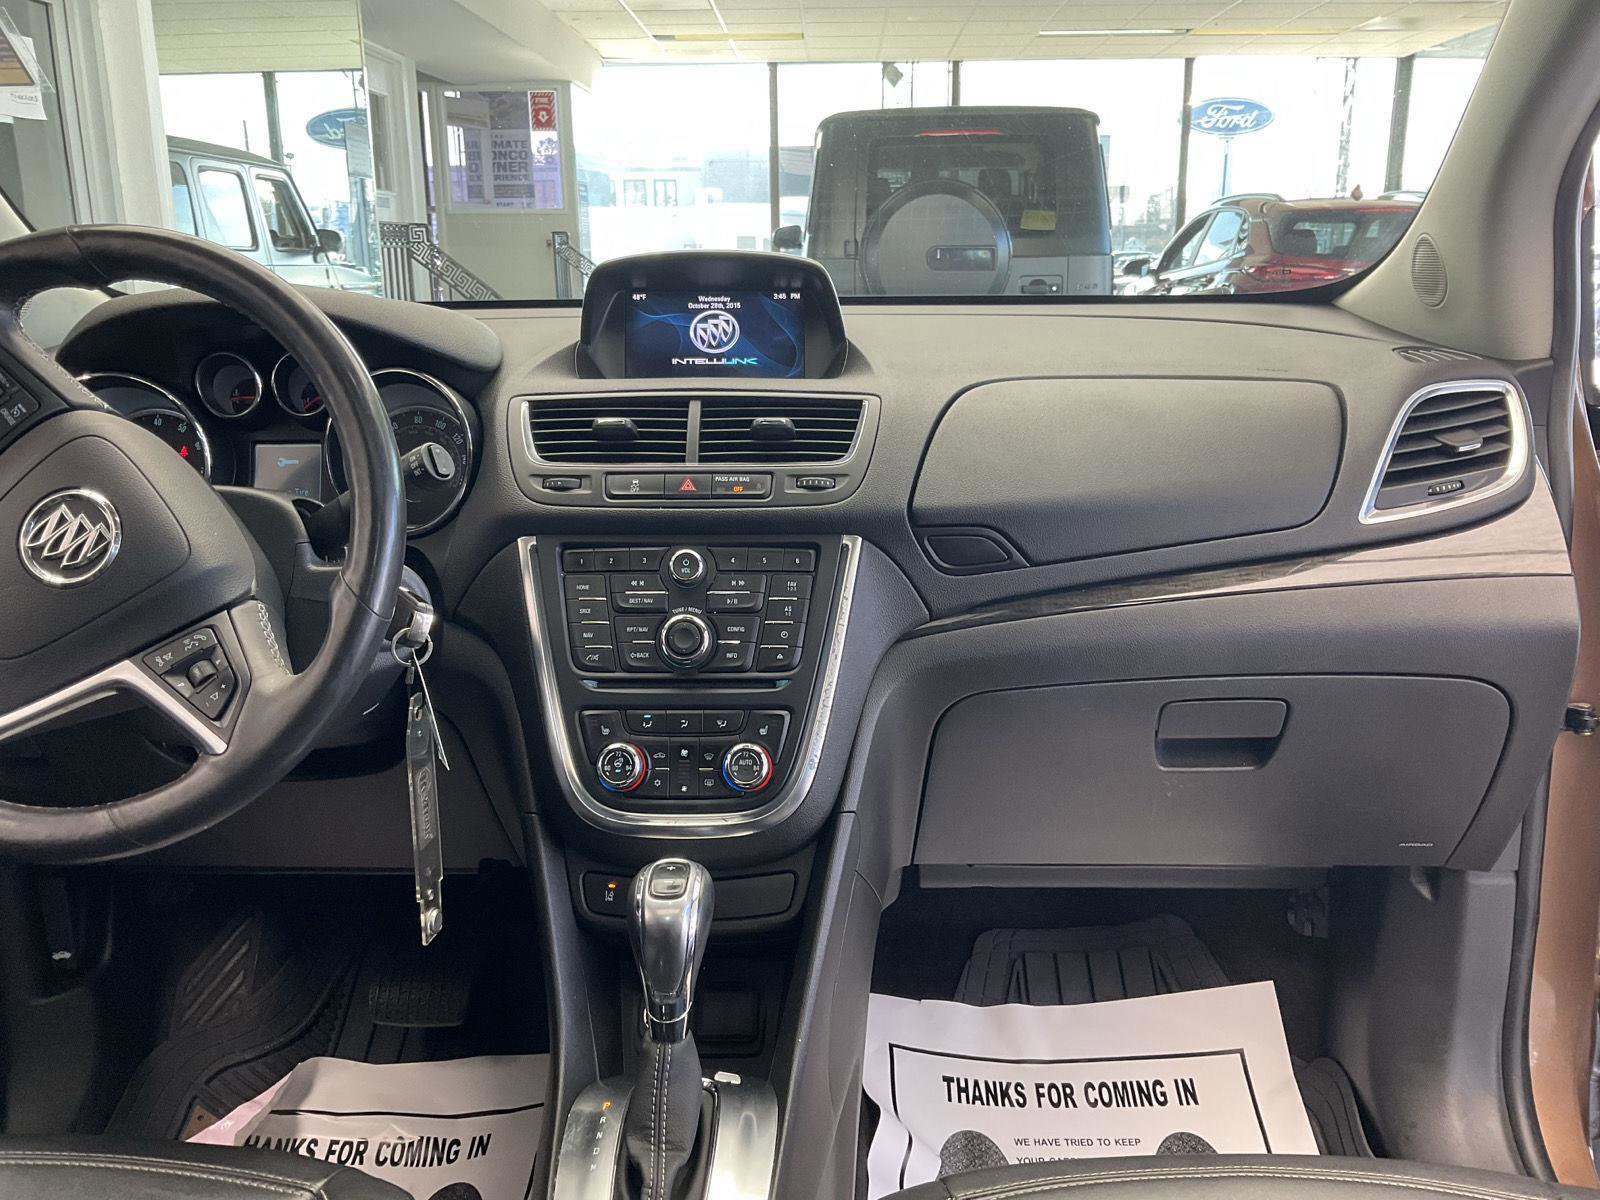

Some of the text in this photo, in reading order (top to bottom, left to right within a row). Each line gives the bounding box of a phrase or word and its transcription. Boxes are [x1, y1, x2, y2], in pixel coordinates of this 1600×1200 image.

[1196, 104, 1259, 129] Ford
[698, 295, 731, 303] Wednesday
[671, 357, 758, 365] INTELLILINK
[153, 417, 162, 426] 40
[414, 416, 423, 424] 80
[435, 419, 447, 430] 100
[177, 422, 187, 433] 50
[942, 1075, 1200, 1109] THANKS FOR COMING IN
[602, 1102, 611, 1111] P
[599, 1116, 607, 1124] R
[595, 1131, 603, 1140] N
[1014, 1138, 1141, 1146] WE HAVE TRIED TO KEEP
[244, 1133, 493, 1168] HANKS FOR COMING IN
